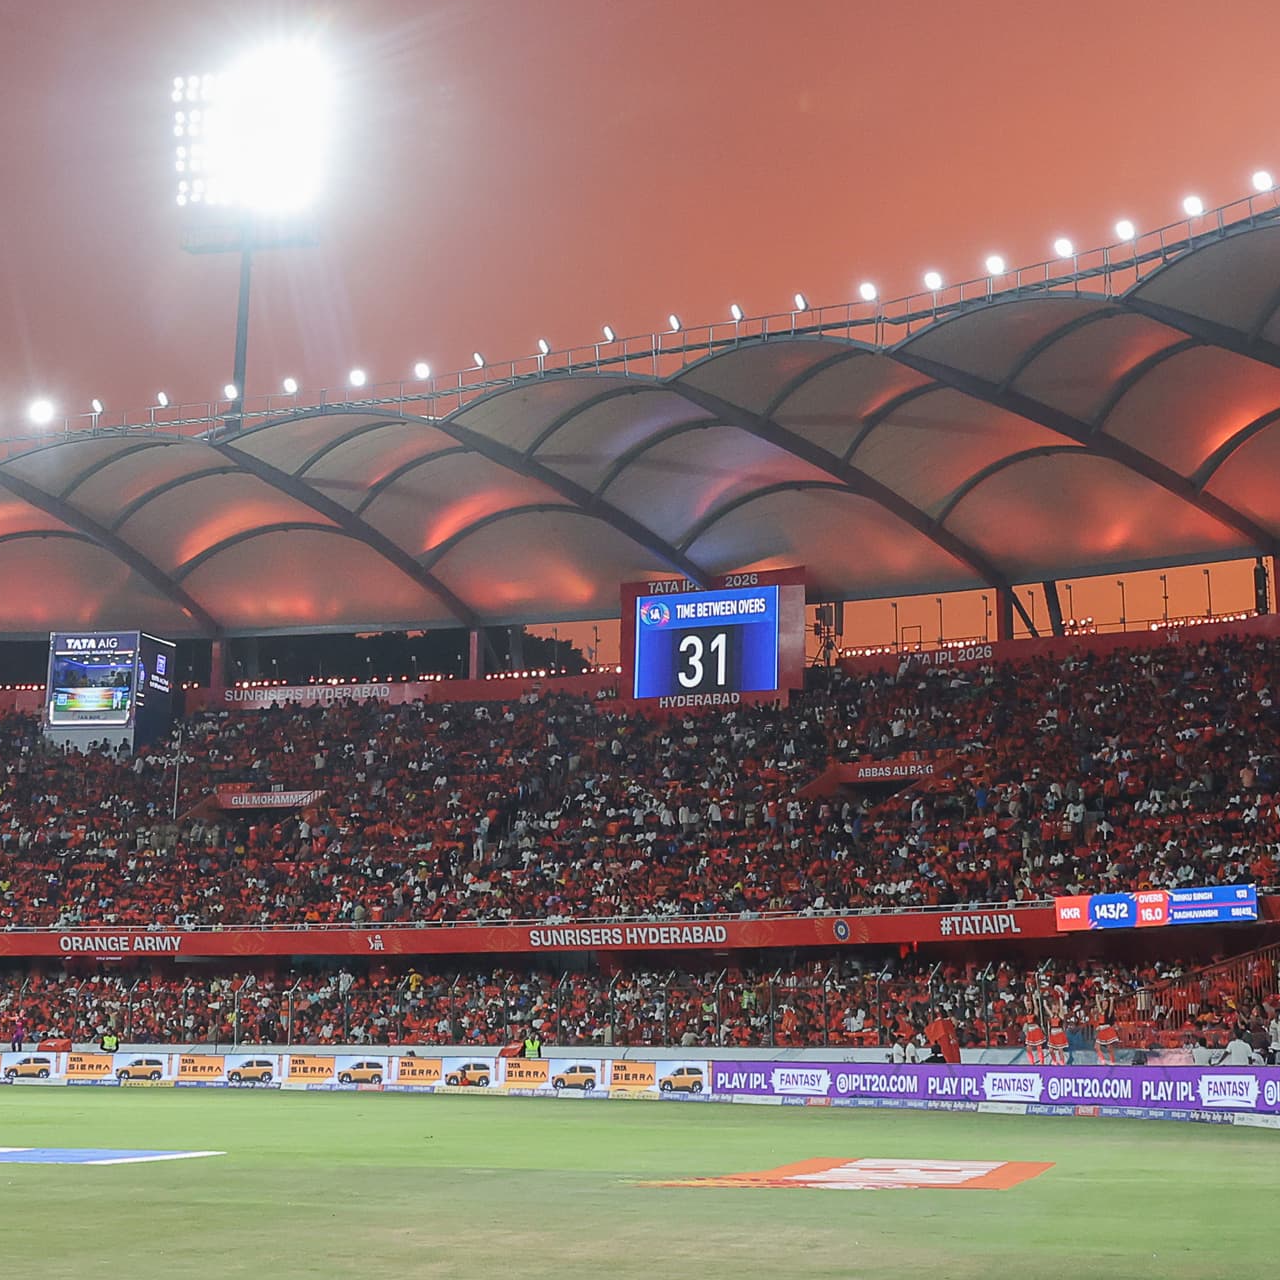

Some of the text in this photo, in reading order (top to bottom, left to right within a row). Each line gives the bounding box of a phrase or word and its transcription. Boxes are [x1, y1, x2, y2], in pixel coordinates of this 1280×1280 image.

[648, 581, 679, 594] TATA
[725, 574, 758, 587] 2026
[676, 604, 696, 620] TIME
[697, 600, 737, 618] BETWEEN
[738, 598, 766, 614] OVERS
[66, 638, 118, 650] TATA AIG
[677, 633, 727, 689] 31
[935, 651, 955, 665] IPL
[958, 646, 993, 662] 2026
[224, 686, 390, 702] SUNRISERS HYDERABAD
[659, 692, 740, 709] HYDERABAD
[858, 768, 891, 778] ABBAS
[893, 766, 908, 776] ALI
[232, 796, 251, 805] GUL
[1138, 893, 1163, 904] OVERS
[1060, 907, 1080, 919] KKR
[1094, 903, 1128, 920] 143/2
[1141, 908, 1163, 921] 16.0
[940, 914, 1021, 935] #TATAIPL
[60, 936, 182, 952] ORANGE ARMY
[530, 926, 727, 946] SUNRISERS HYDERABAD
[291, 1066, 332, 1074] SIERRA
[506, 1070, 547, 1078] SIERRA
[613, 1072, 653, 1081] SIERRA
[717, 1072, 918, 1093] PLAY IPL FANTASY @IPLT20.COM
[928, 1076, 1132, 1100] PLAY IPL FANTASY @IPLT20.COM
[1142, 1081, 1174, 1101] PLAY
[1176, 1082, 1196, 1102] IPL
[1207, 1081, 1250, 1096] FANTASY
